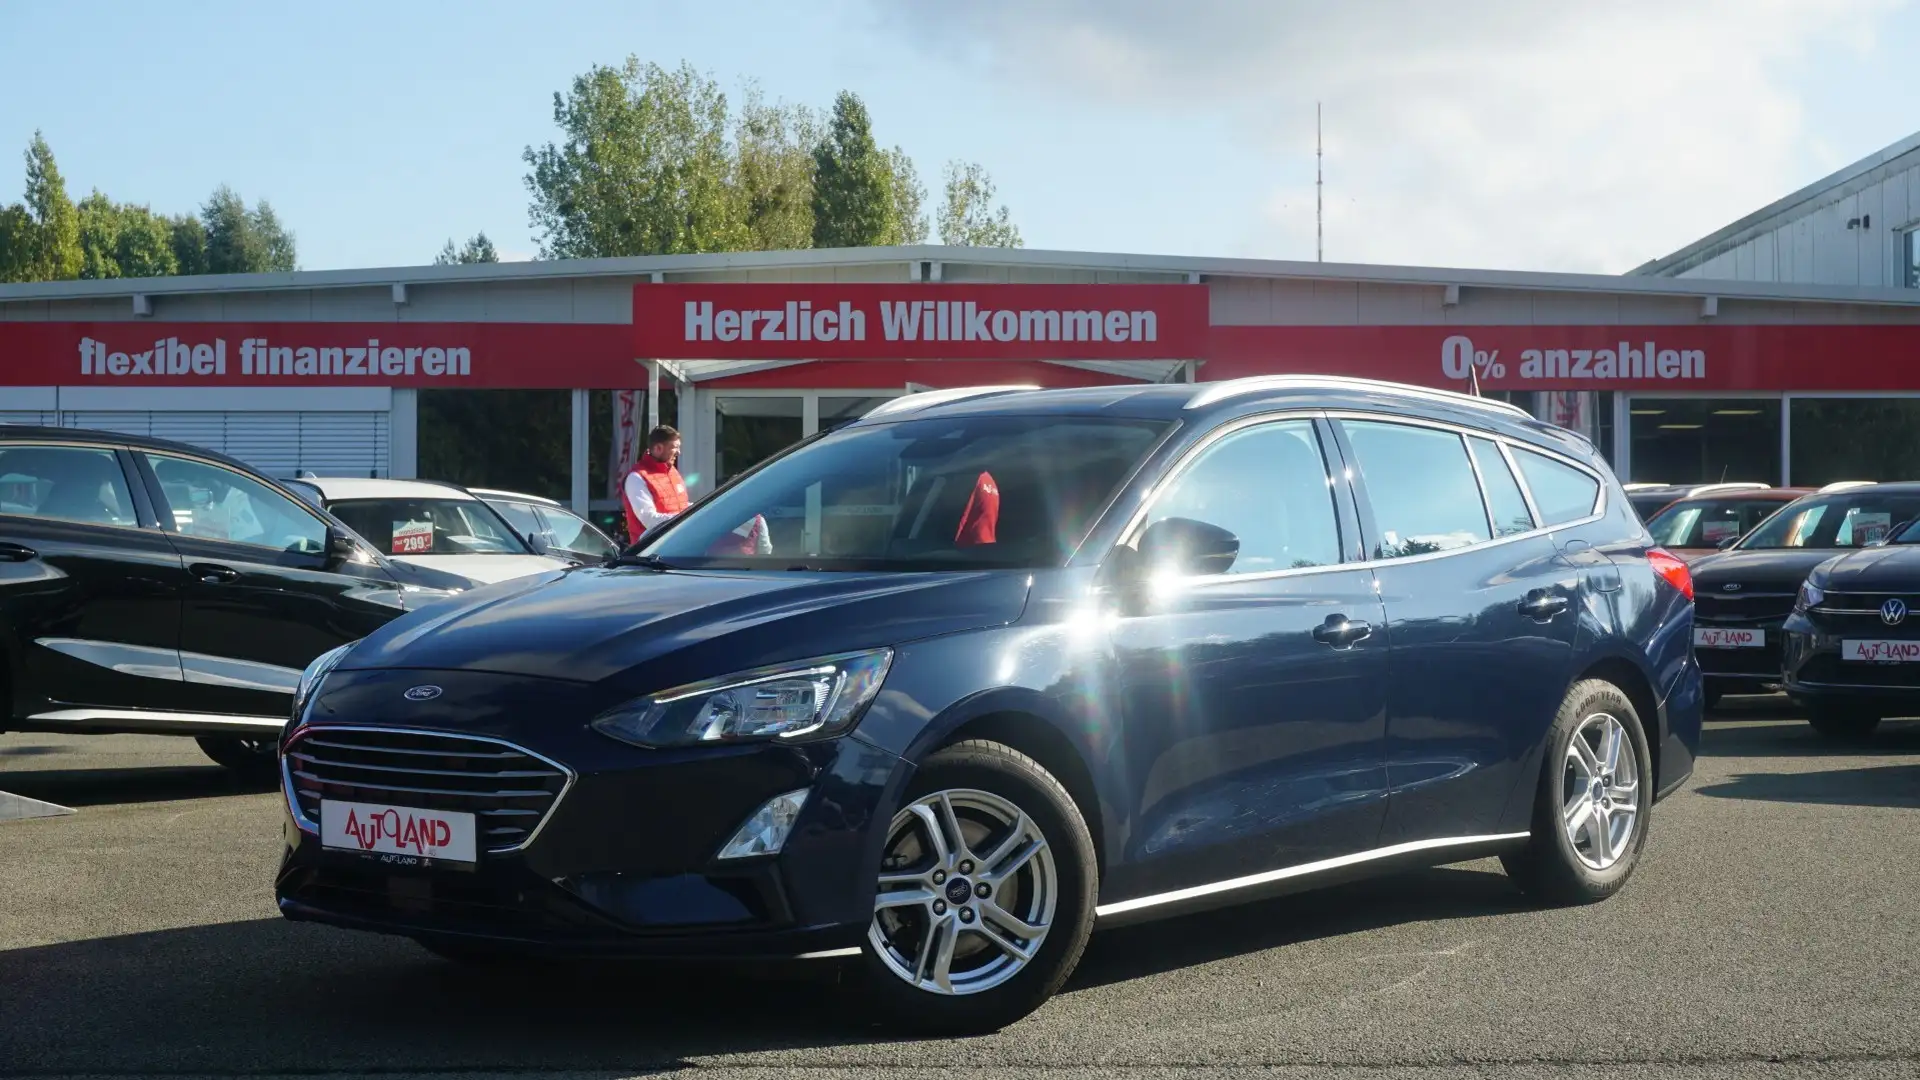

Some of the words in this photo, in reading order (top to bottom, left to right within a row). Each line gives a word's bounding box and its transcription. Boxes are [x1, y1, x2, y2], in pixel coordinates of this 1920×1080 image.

[684, 301, 866, 342] Herzlich
[879, 301, 1158, 342] Willkommen
[78, 336, 226, 376] flexibel
[239, 337, 471, 376] finanzieren
[1441, 335, 1506, 380] 0%
[1519, 341, 1706, 379] anzahlen
[1701, 631, 1753, 645] AUTOLAND
[1857, 641, 1920, 661] AUTOLAND
[345, 808, 451, 854] AUTOLAND
